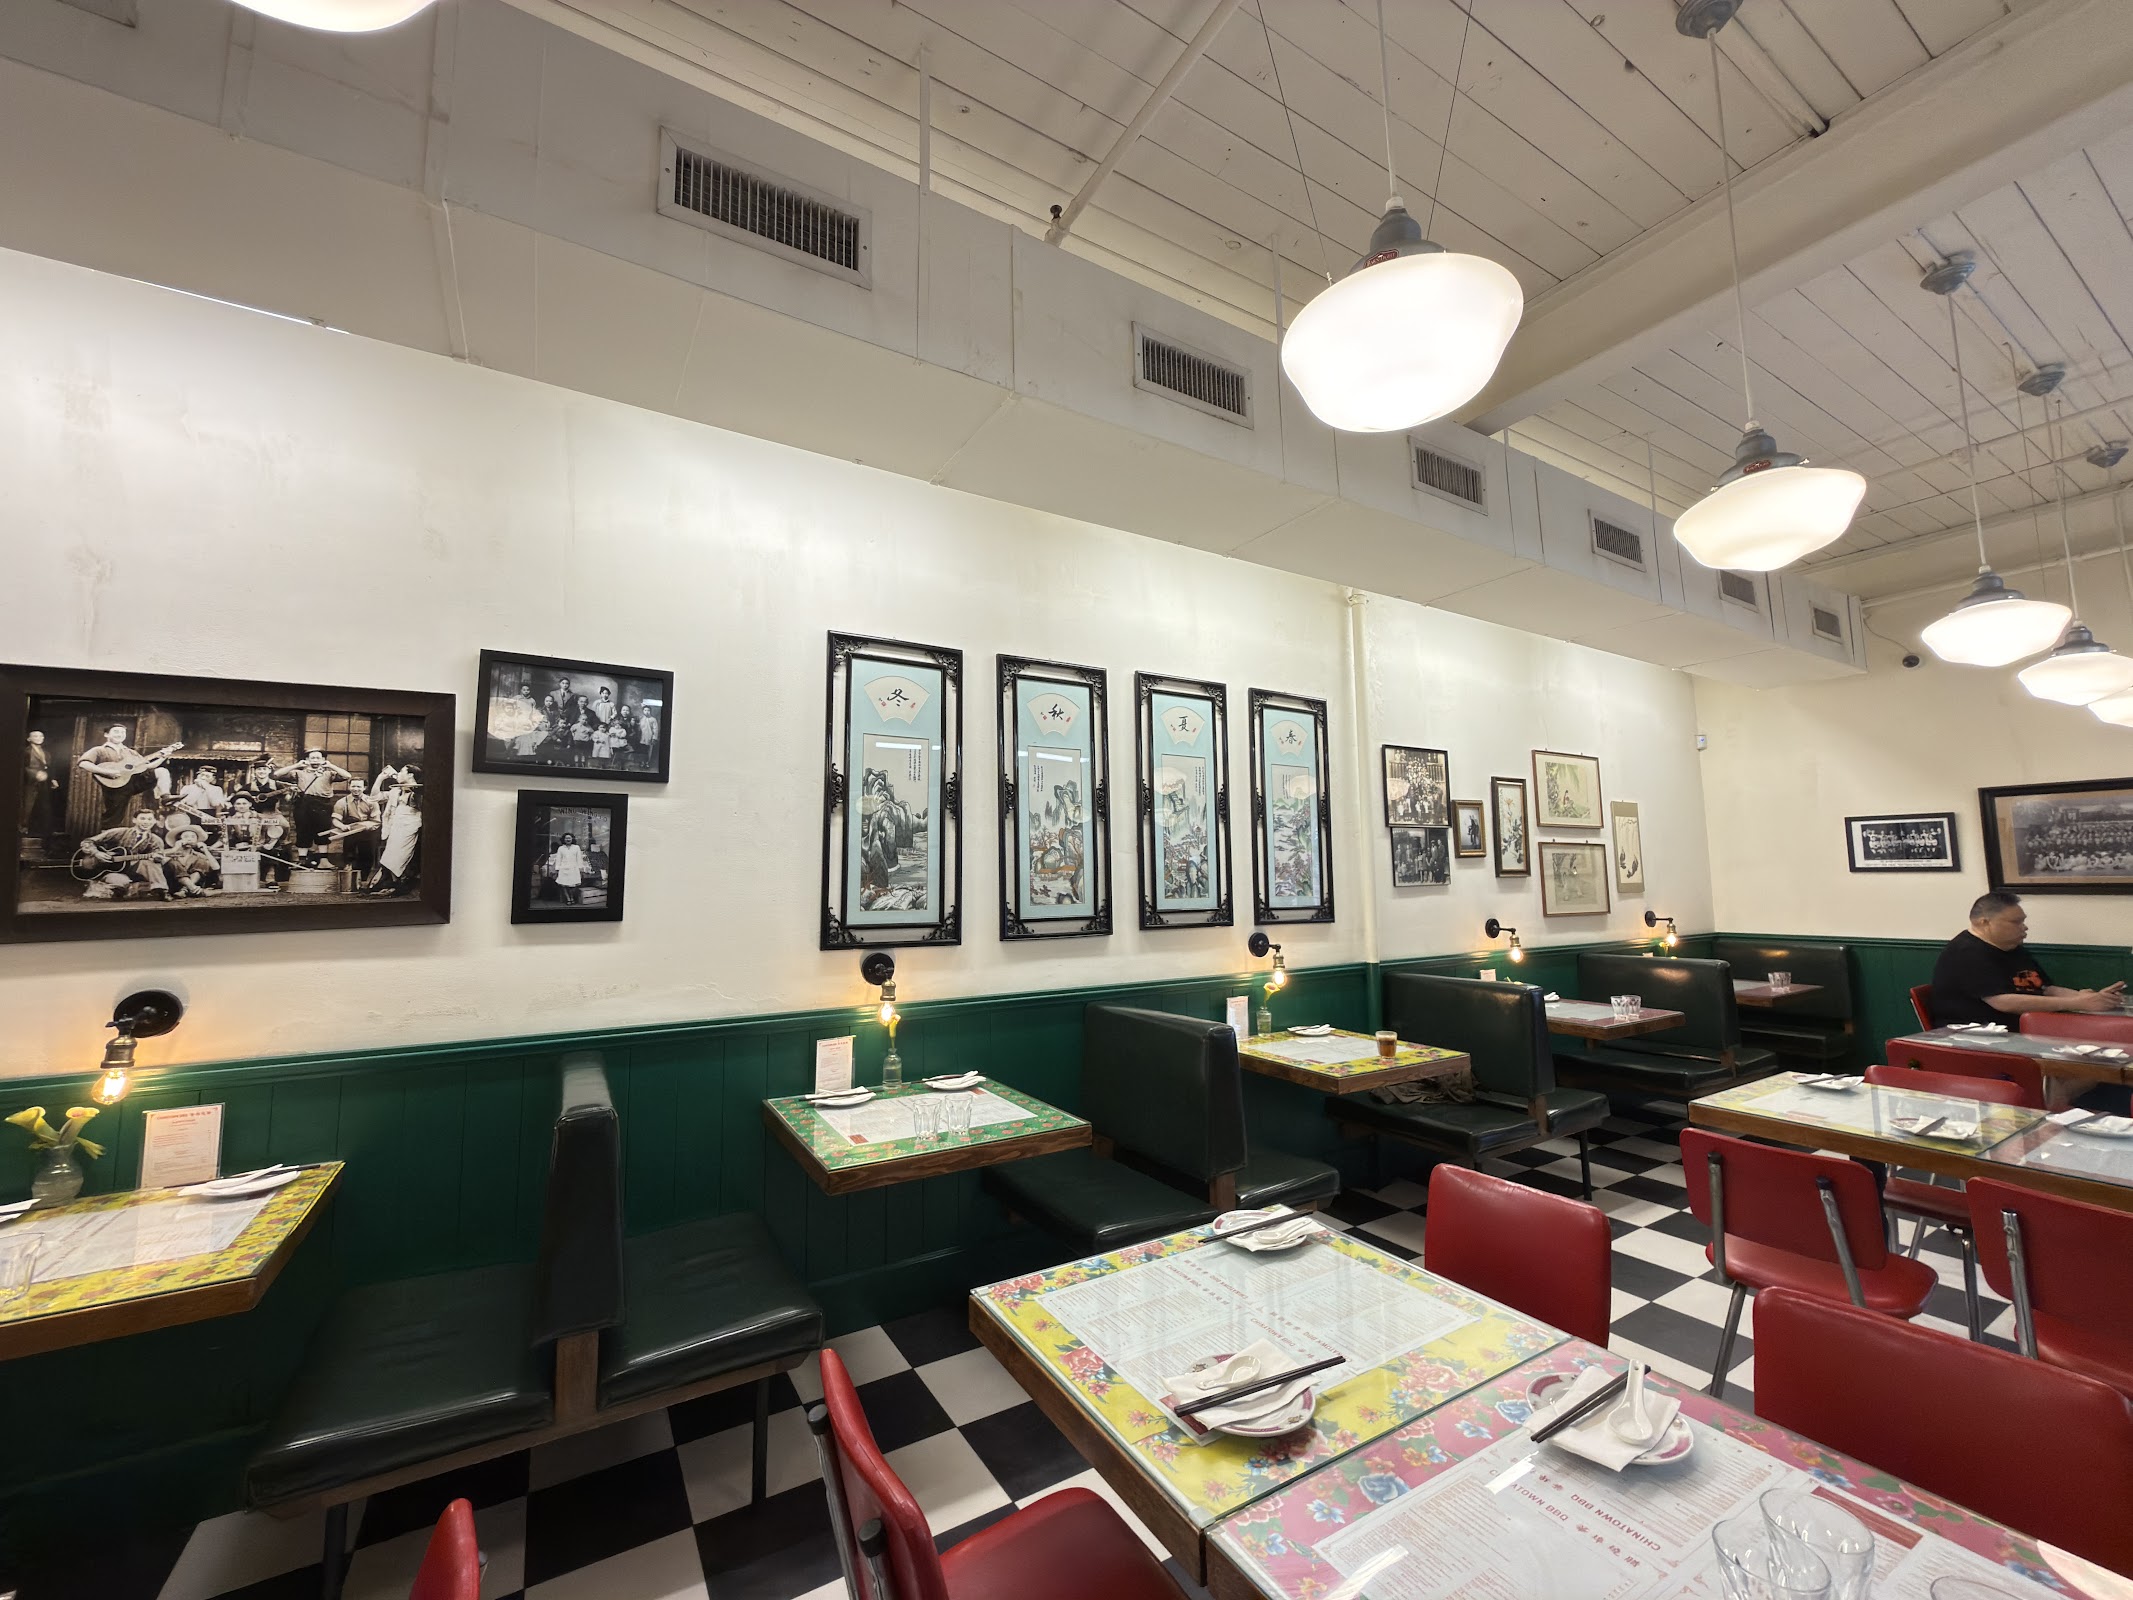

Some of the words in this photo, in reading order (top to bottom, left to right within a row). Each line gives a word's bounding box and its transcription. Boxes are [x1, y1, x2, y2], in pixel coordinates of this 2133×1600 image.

[887, 688, 910, 707] 冬
[1048, 703, 1065, 720] 秋
[1178, 715, 1189, 732] 夏
[1285, 729, 1298, 745] 春
[1489, 1469, 1546, 1506] CATOWN
[1545, 1504, 1569, 1521] BBQ
[1570, 1494, 1594, 1510] BBQ
[1594, 1509, 1661, 1551] CHINATOWN
